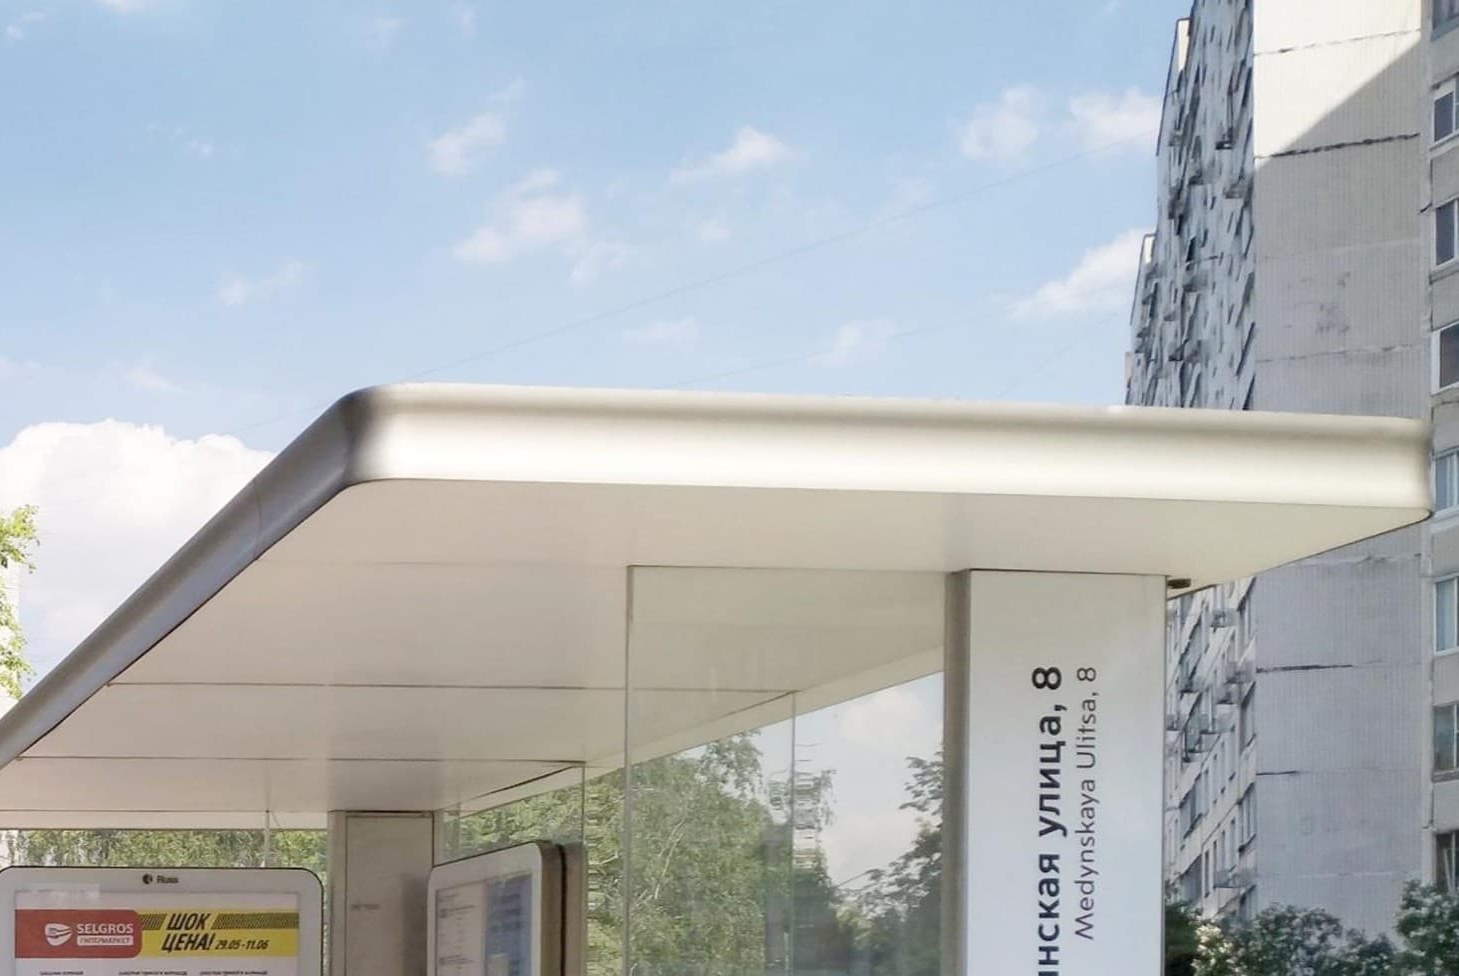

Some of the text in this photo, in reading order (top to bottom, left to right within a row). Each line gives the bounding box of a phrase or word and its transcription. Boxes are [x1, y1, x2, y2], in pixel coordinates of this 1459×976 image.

[1032, 666, 1063, 691] 8
[1038, 703, 1068, 837] улица,
[1075, 666, 1100, 940] Medynskaya Ulitsa, 8
[77, 923, 134, 934] SELGROS
[165, 913, 211, 931] ШОК
[161, 933, 216, 953] ЦЕНА!
